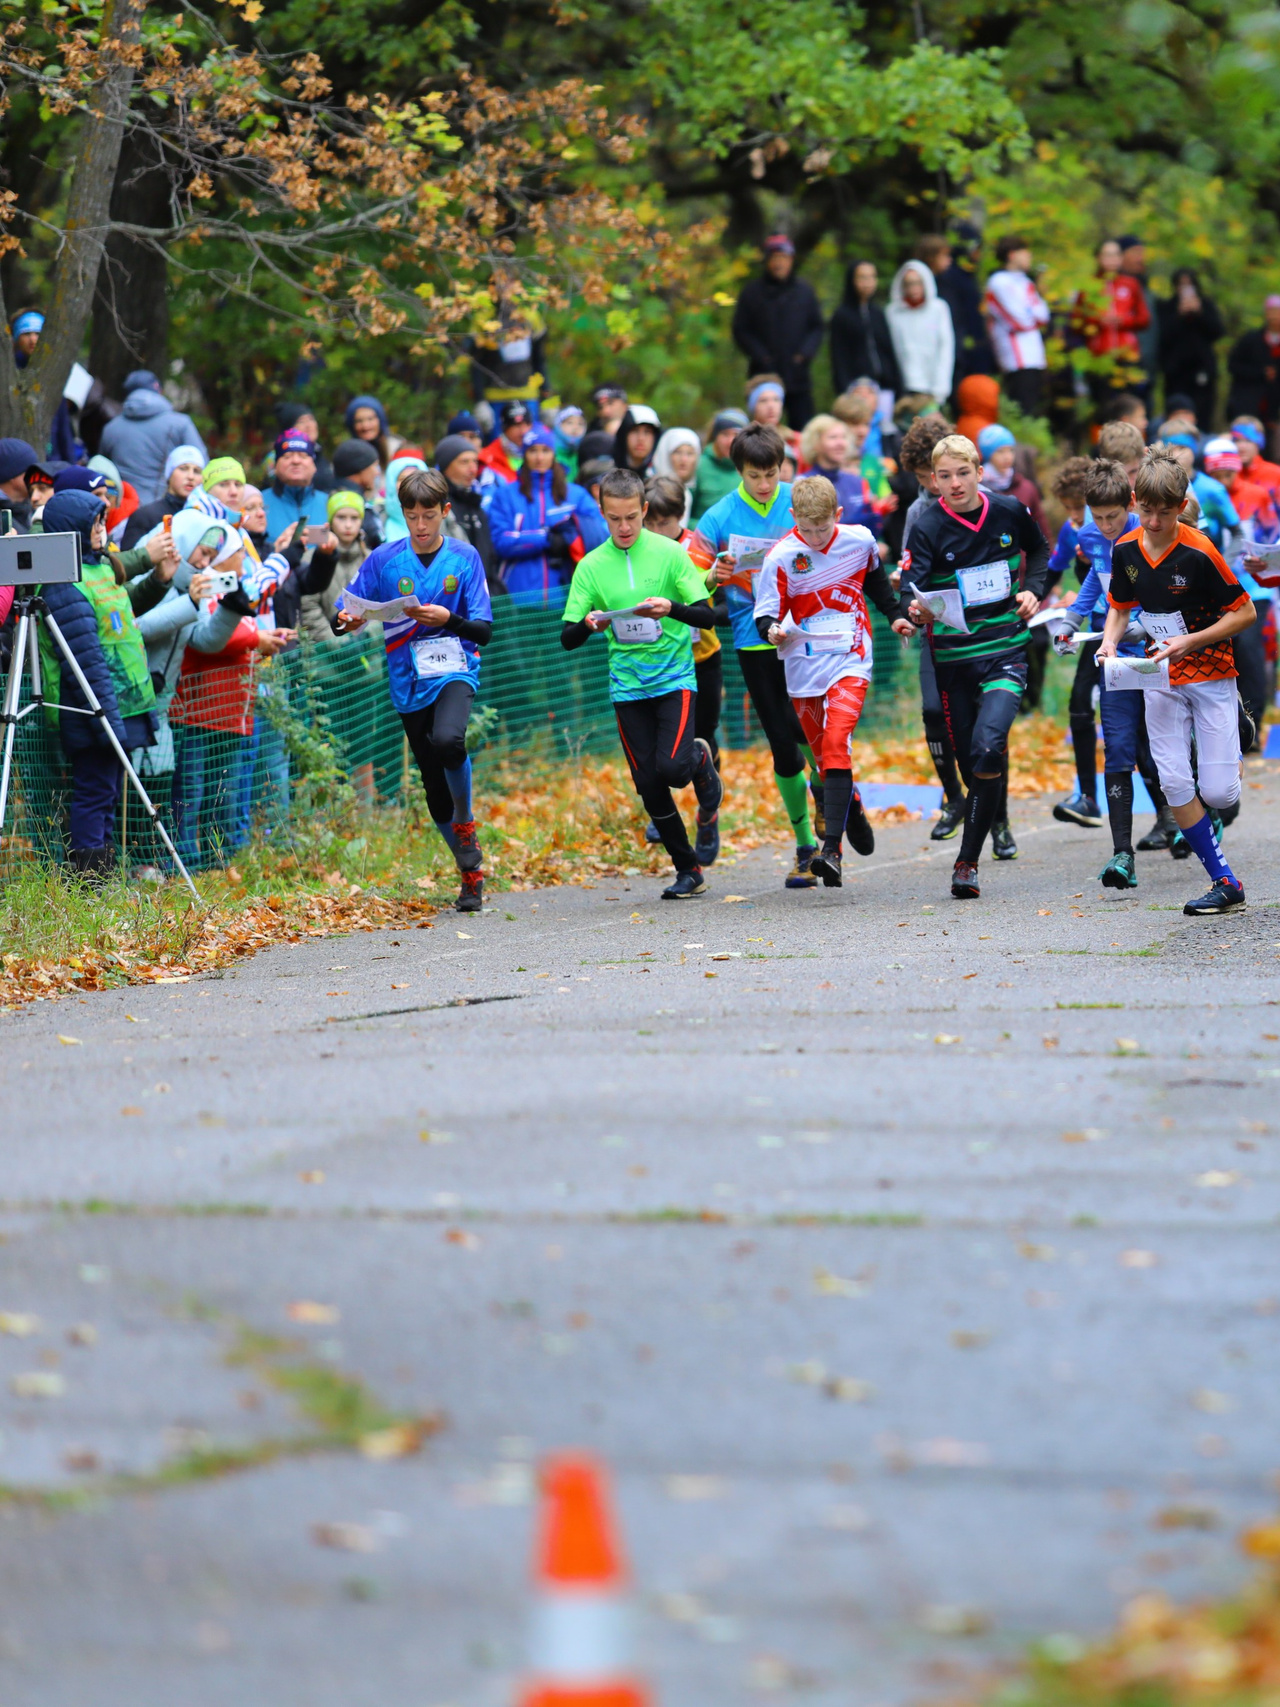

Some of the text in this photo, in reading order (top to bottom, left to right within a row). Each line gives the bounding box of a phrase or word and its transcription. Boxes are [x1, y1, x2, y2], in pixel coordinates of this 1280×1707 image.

[977, 579, 994, 591] 234
[830, 589, 853, 606] Run
[626, 623, 643, 632] 247
[1152, 625, 1169, 634] 231
[429, 653, 448, 664] 248
